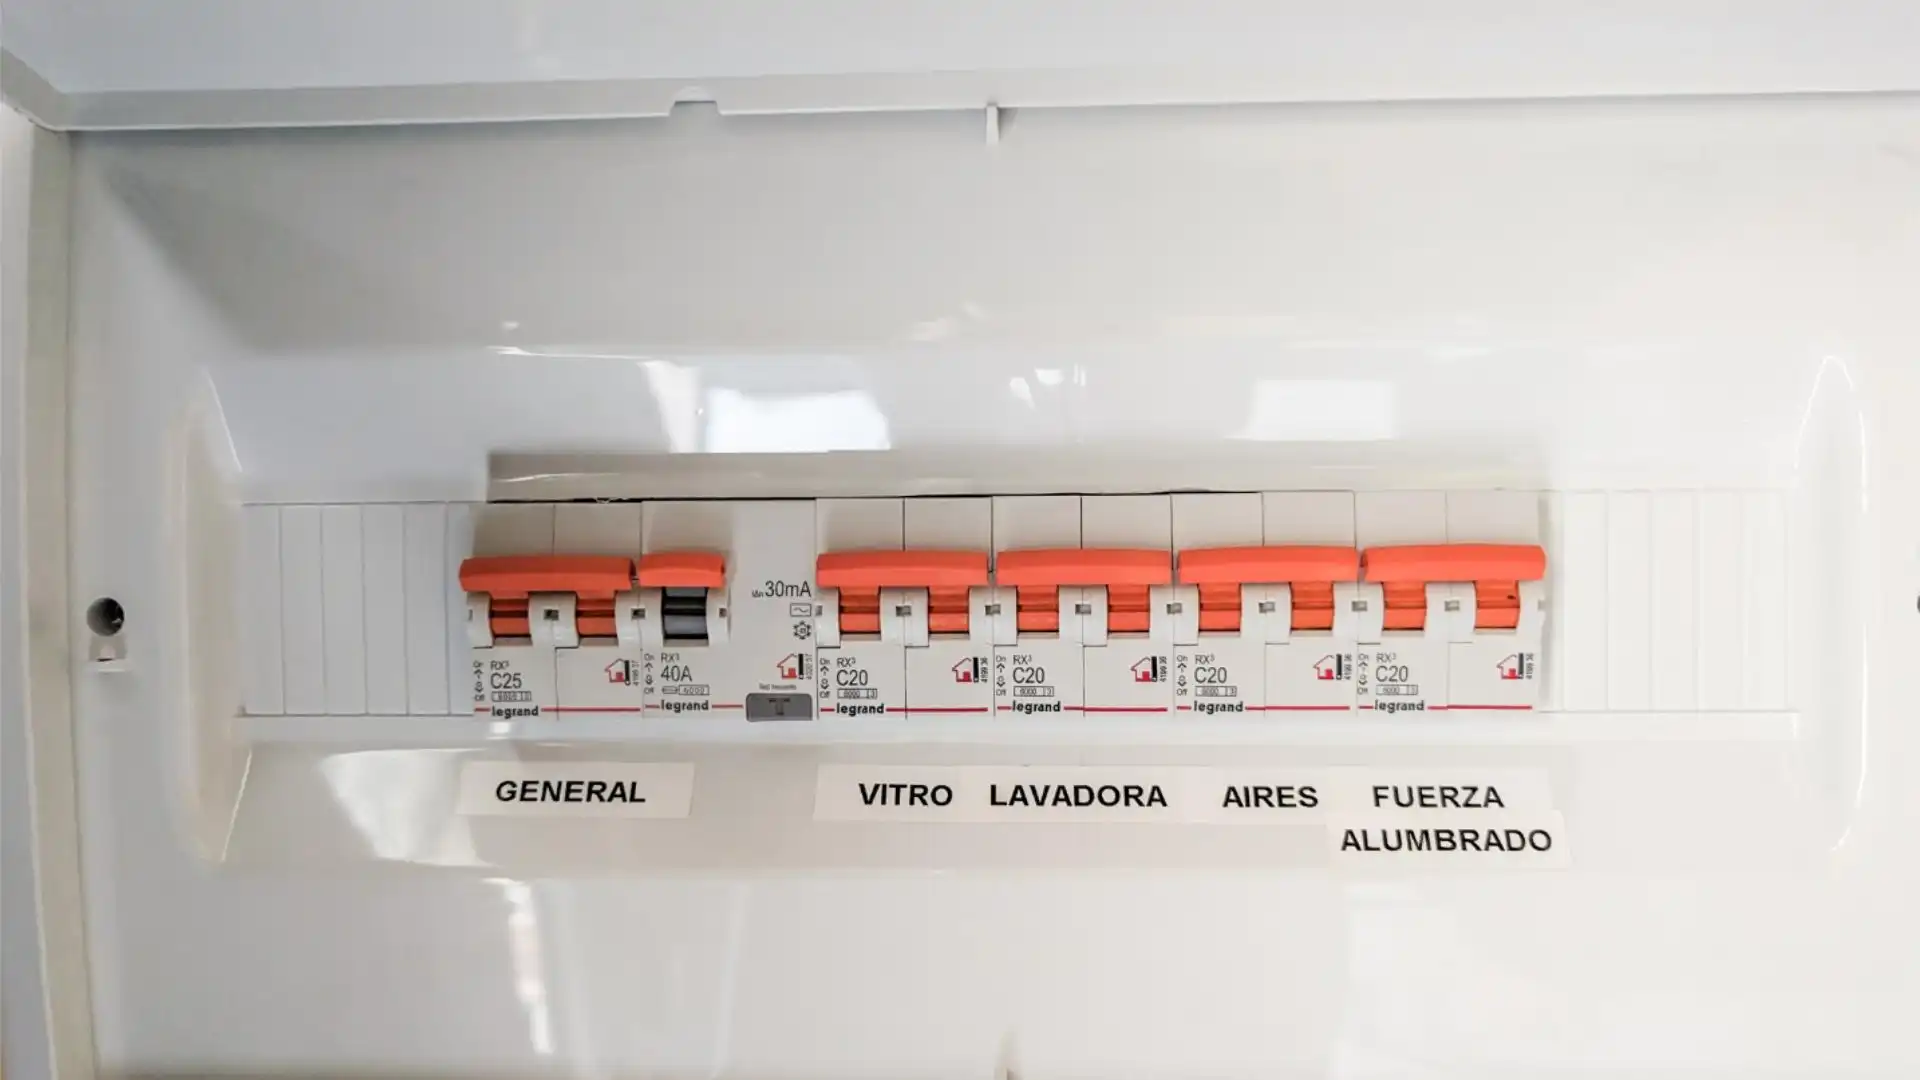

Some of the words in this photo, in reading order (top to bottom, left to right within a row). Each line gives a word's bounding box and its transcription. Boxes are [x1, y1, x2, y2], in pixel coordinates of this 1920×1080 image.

[765, 579, 812, 597] 30mA
[490, 672, 522, 689] C25
[661, 665, 693, 682] 40A
[836, 669, 869, 687] C20
[1013, 667, 1045, 684] C20
[1194, 667, 1227, 684] C20
[1376, 665, 1408, 683] C20
[491, 704, 539, 719] legrand
[661, 700, 709, 713] legrand
[837, 702, 885, 716] legrand
[1013, 700, 1061, 714] legrand
[1194, 700, 1243, 715] legrand
[1375, 700, 1424, 714] legrand
[495, 780, 646, 803] GENERAL
[858, 783, 953, 807] VITRO
[990, 784, 1168, 808] LAVADORA
[1222, 786, 1319, 808] AIRES
[1373, 786, 1506, 808] FUERZA
[1341, 829, 1552, 852] ALUMBRADO
